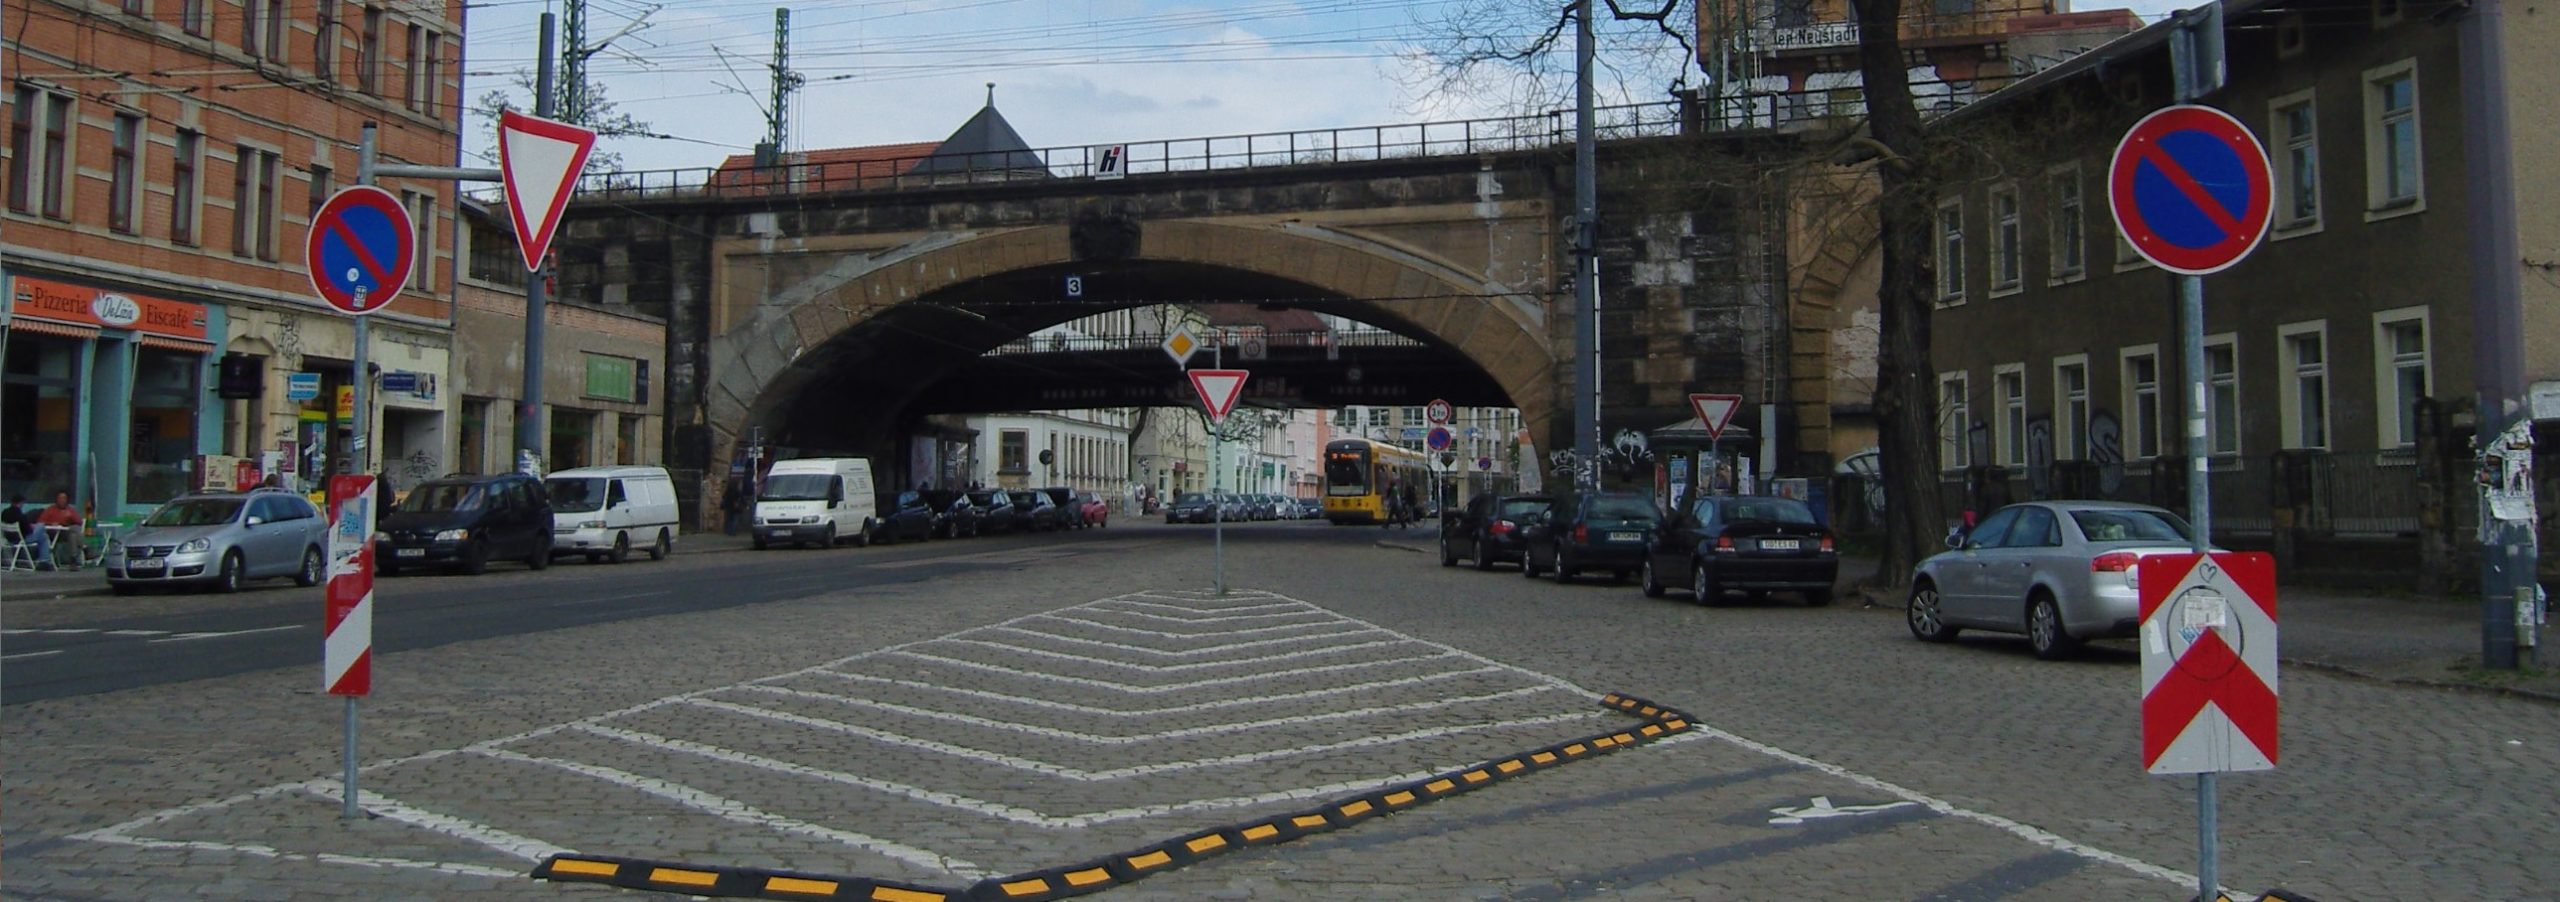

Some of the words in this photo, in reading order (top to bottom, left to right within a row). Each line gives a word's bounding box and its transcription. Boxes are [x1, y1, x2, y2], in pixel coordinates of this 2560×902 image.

[1069, 279, 1079, 293] 3
[34, 286, 88, 315] Pizzeria
[146, 304, 188, 329] Eiscafé
